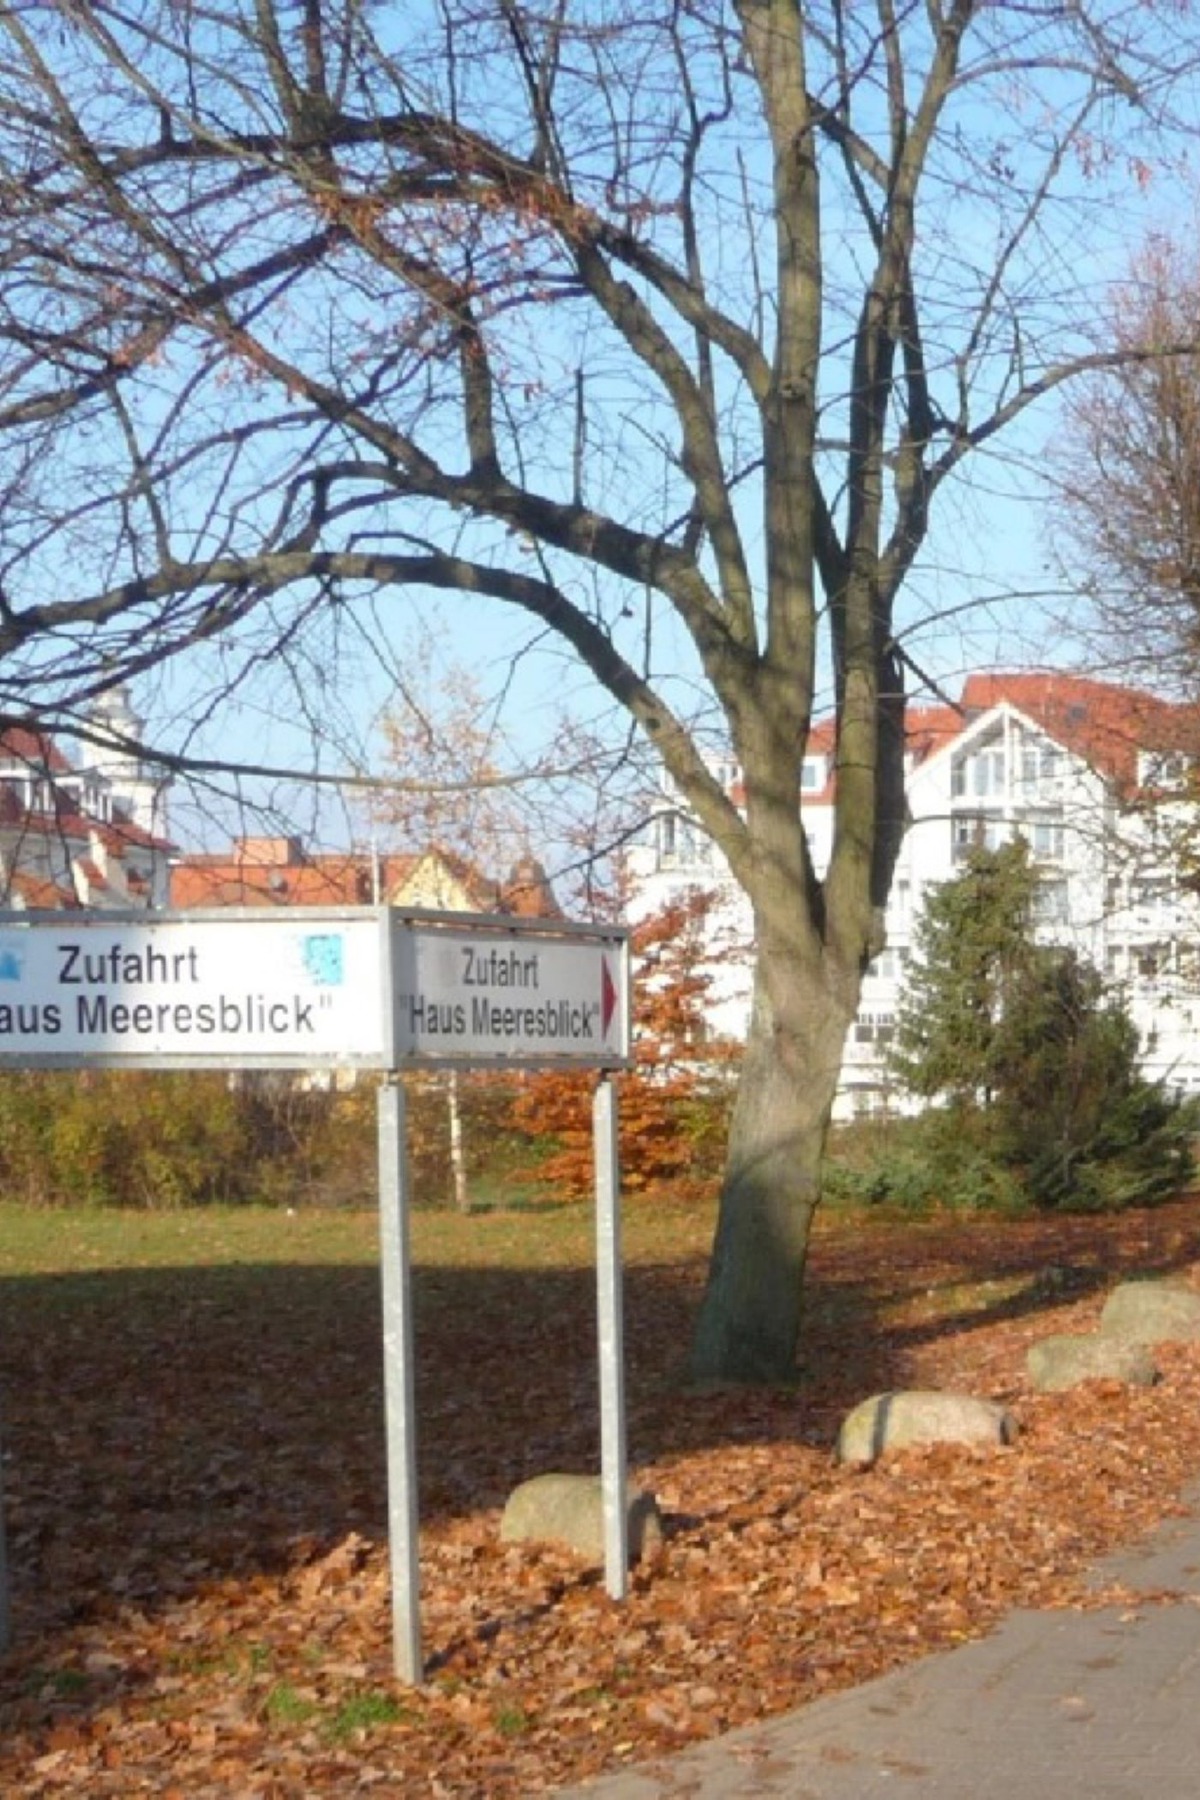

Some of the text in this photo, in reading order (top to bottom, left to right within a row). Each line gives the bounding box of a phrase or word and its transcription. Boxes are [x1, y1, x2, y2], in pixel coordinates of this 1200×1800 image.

[57, 944, 199, 984] Zufahrt
[461, 947, 539, 989] Zufahrt
[77, 994, 333, 1034] Meeresblick"
[400, 994, 600, 1039] "Haus Meeresblick"
